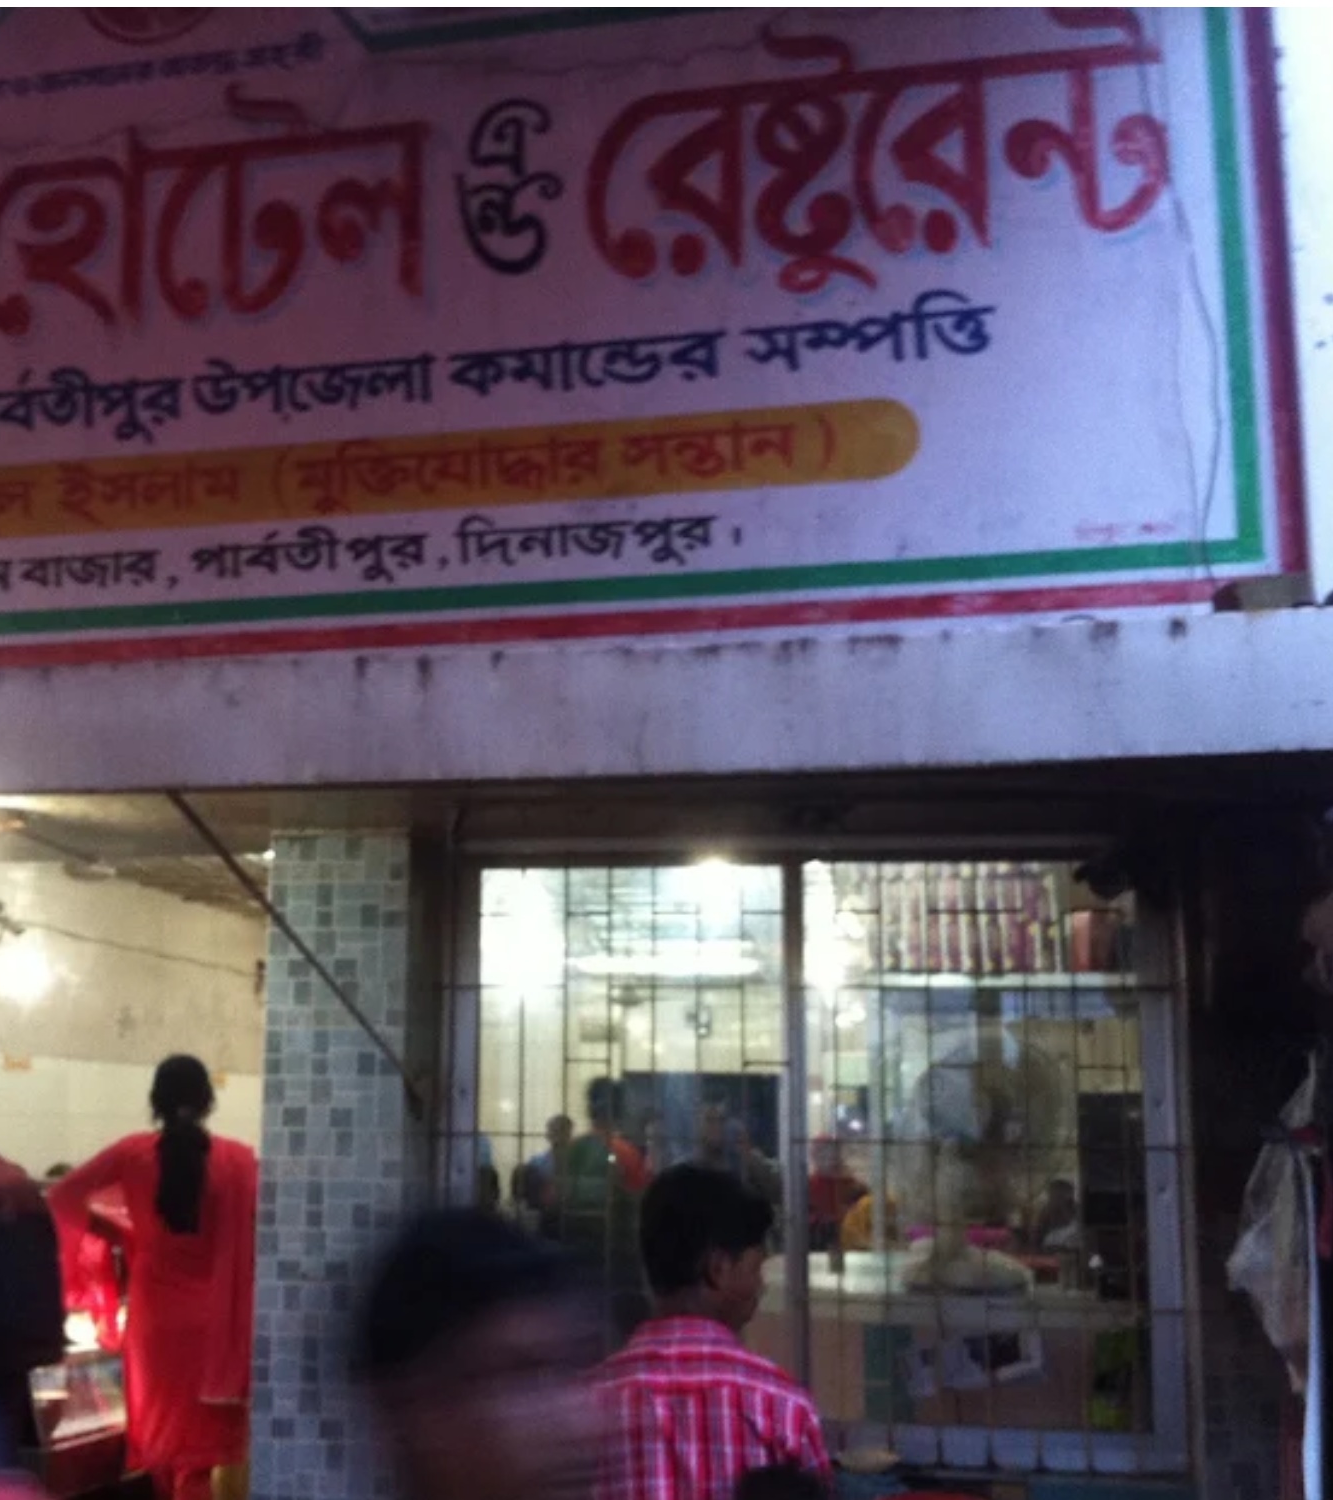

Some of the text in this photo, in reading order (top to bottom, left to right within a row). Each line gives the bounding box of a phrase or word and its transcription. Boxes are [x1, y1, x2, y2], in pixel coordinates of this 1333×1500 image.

[448, 328, 727, 398] কমান্ডের
[740, 289, 995, 372] সম্পত্তি
[56, 459, 241, 526] ইসলাম
